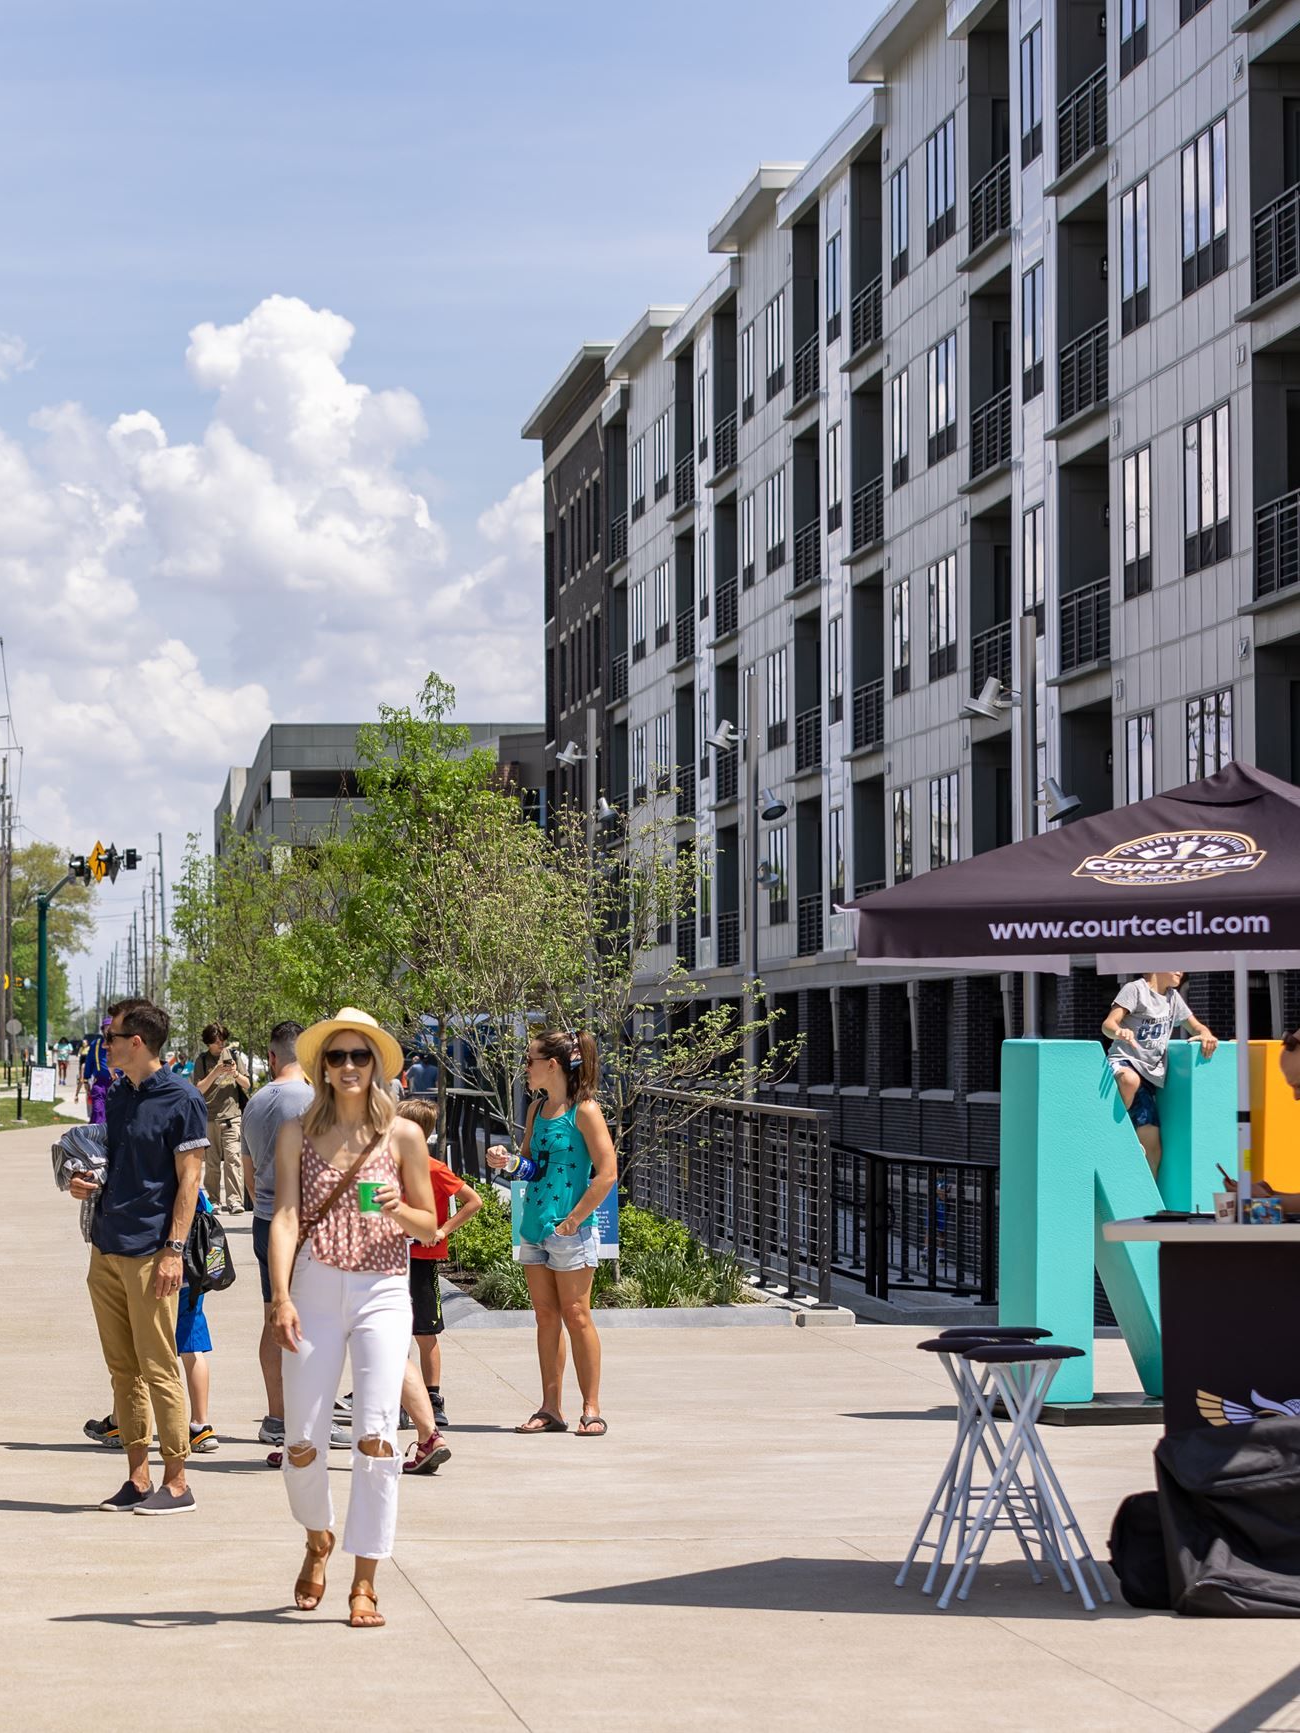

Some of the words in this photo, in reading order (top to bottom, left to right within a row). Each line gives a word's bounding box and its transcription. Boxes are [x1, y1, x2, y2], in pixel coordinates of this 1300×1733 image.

[1084, 859, 1183, 872] COURT
[1183, 855, 1256, 870] CECIL
[988, 910, 1271, 940] www.courtcecil.com
